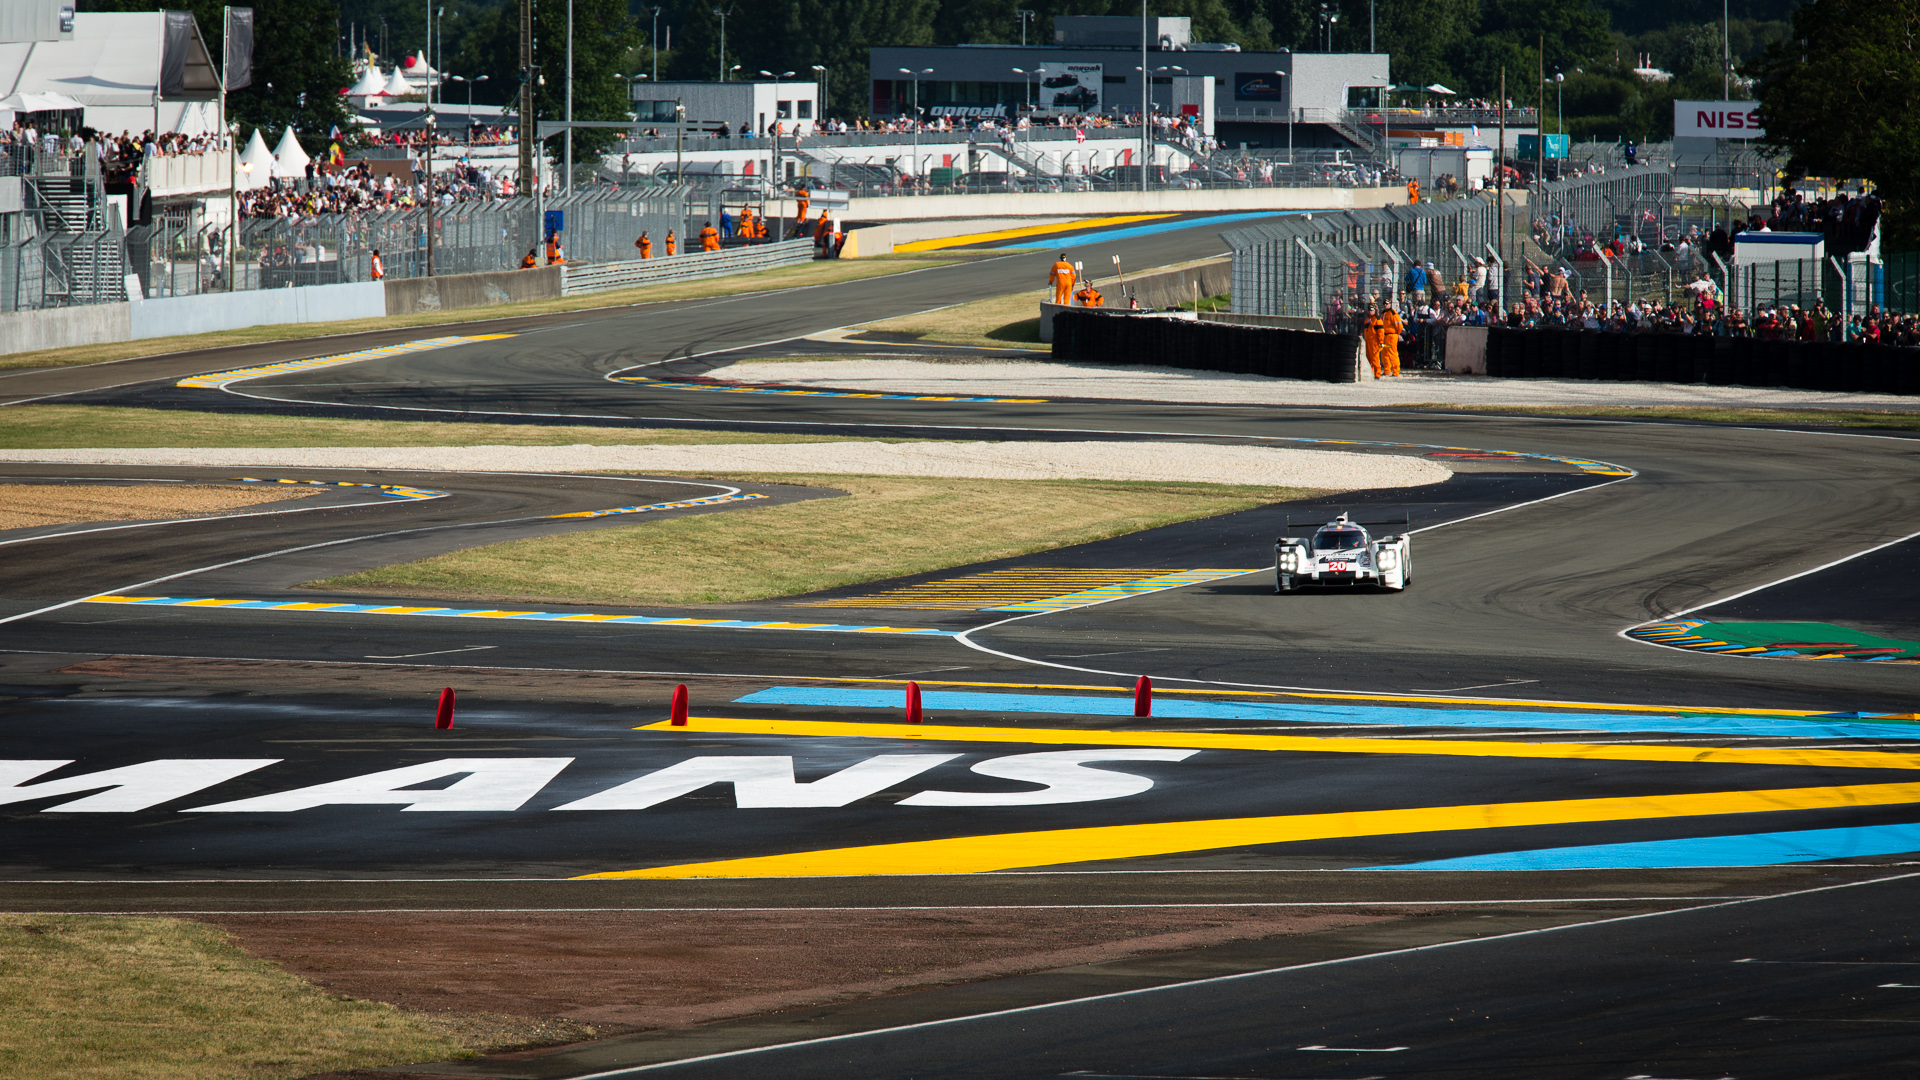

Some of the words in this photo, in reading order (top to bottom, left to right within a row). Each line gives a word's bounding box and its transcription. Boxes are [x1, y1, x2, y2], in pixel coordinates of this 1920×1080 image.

[1697, 111, 1760, 129] NISS
[1329, 562, 1347, 571] 20
[0, 748, 1201, 812] MANS
